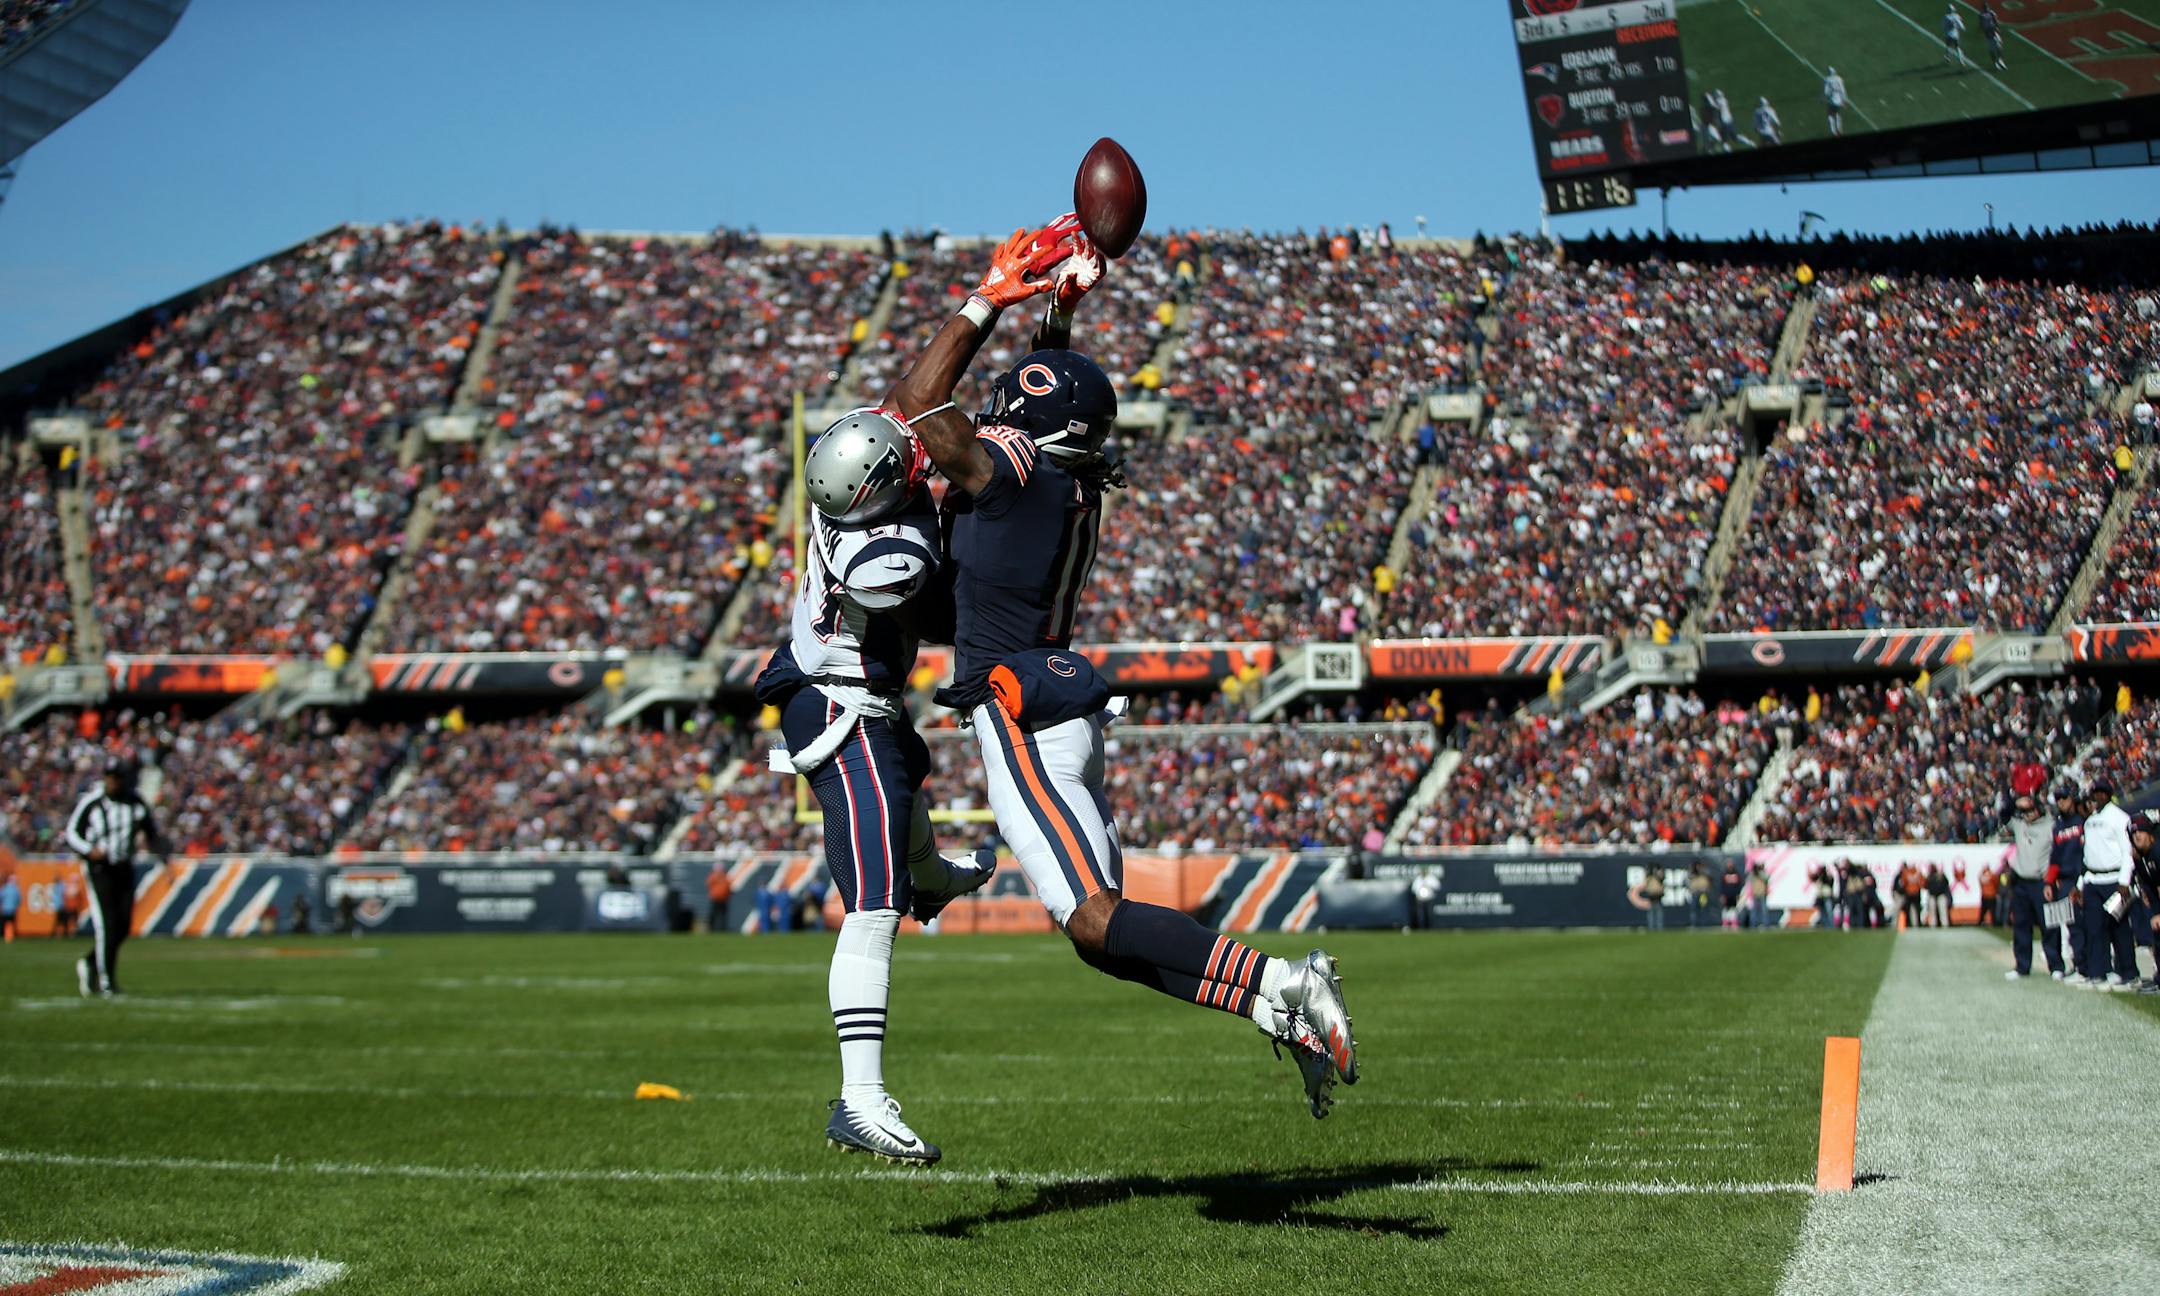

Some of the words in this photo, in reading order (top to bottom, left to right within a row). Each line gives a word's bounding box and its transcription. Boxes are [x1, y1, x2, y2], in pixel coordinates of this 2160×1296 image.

[1561, 46, 1617, 70] EDELMAN
[1568, 87, 1615, 109] BURTON
[1550, 135, 1605, 158] BEARS
[1556, 176, 1631, 209] 11:16
[1019, 363, 1057, 396] C
[1391, 647, 1471, 671] DOWN
